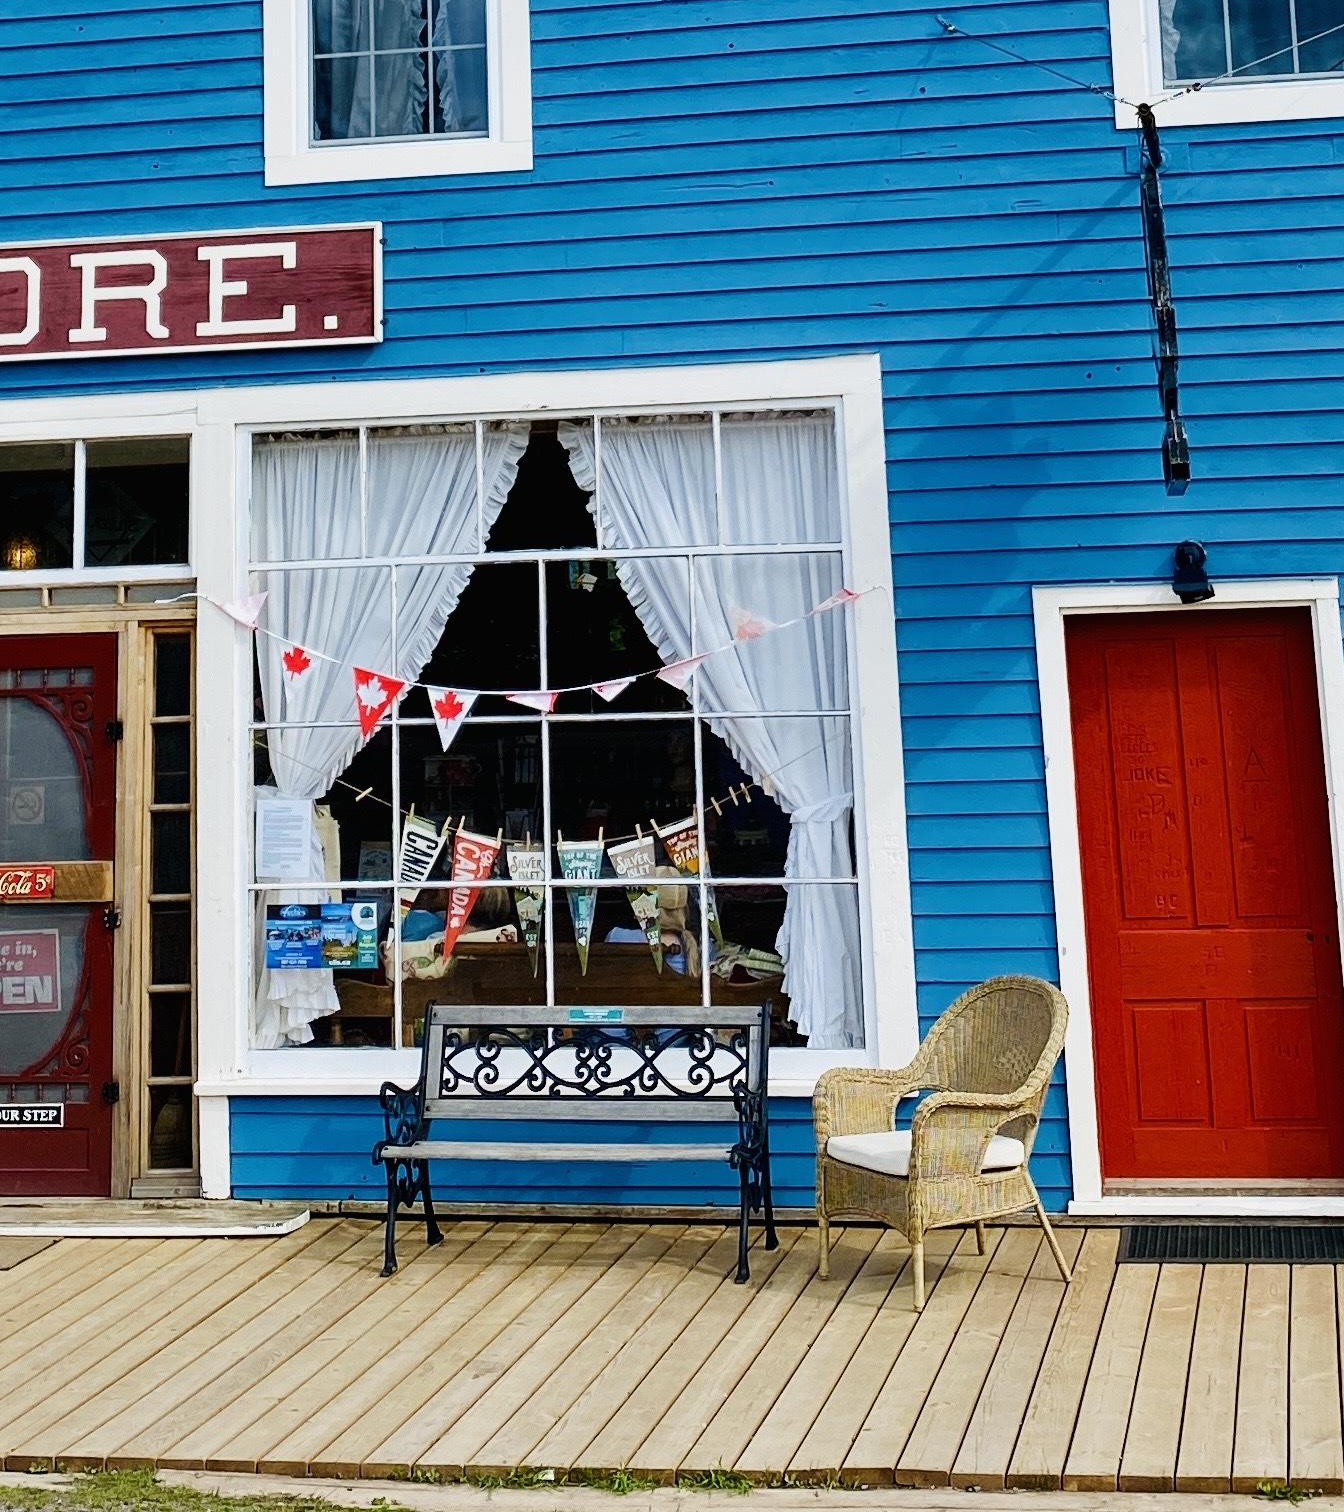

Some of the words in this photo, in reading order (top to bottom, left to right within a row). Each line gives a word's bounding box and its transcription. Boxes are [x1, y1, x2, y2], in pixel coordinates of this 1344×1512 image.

[400, 830, 439, 882] CANAD
[510, 855, 545, 874] SILVER
[616, 850, 655, 875] SILVER
[673, 846, 699, 866] GIAN
[518, 871, 540, 880] ISLET
[564, 868, 597, 879] GIANT
[626, 864, 650, 878] ISLET
[15, 940, 37, 958] in,
[22, 1109, 58, 1121] STEP
